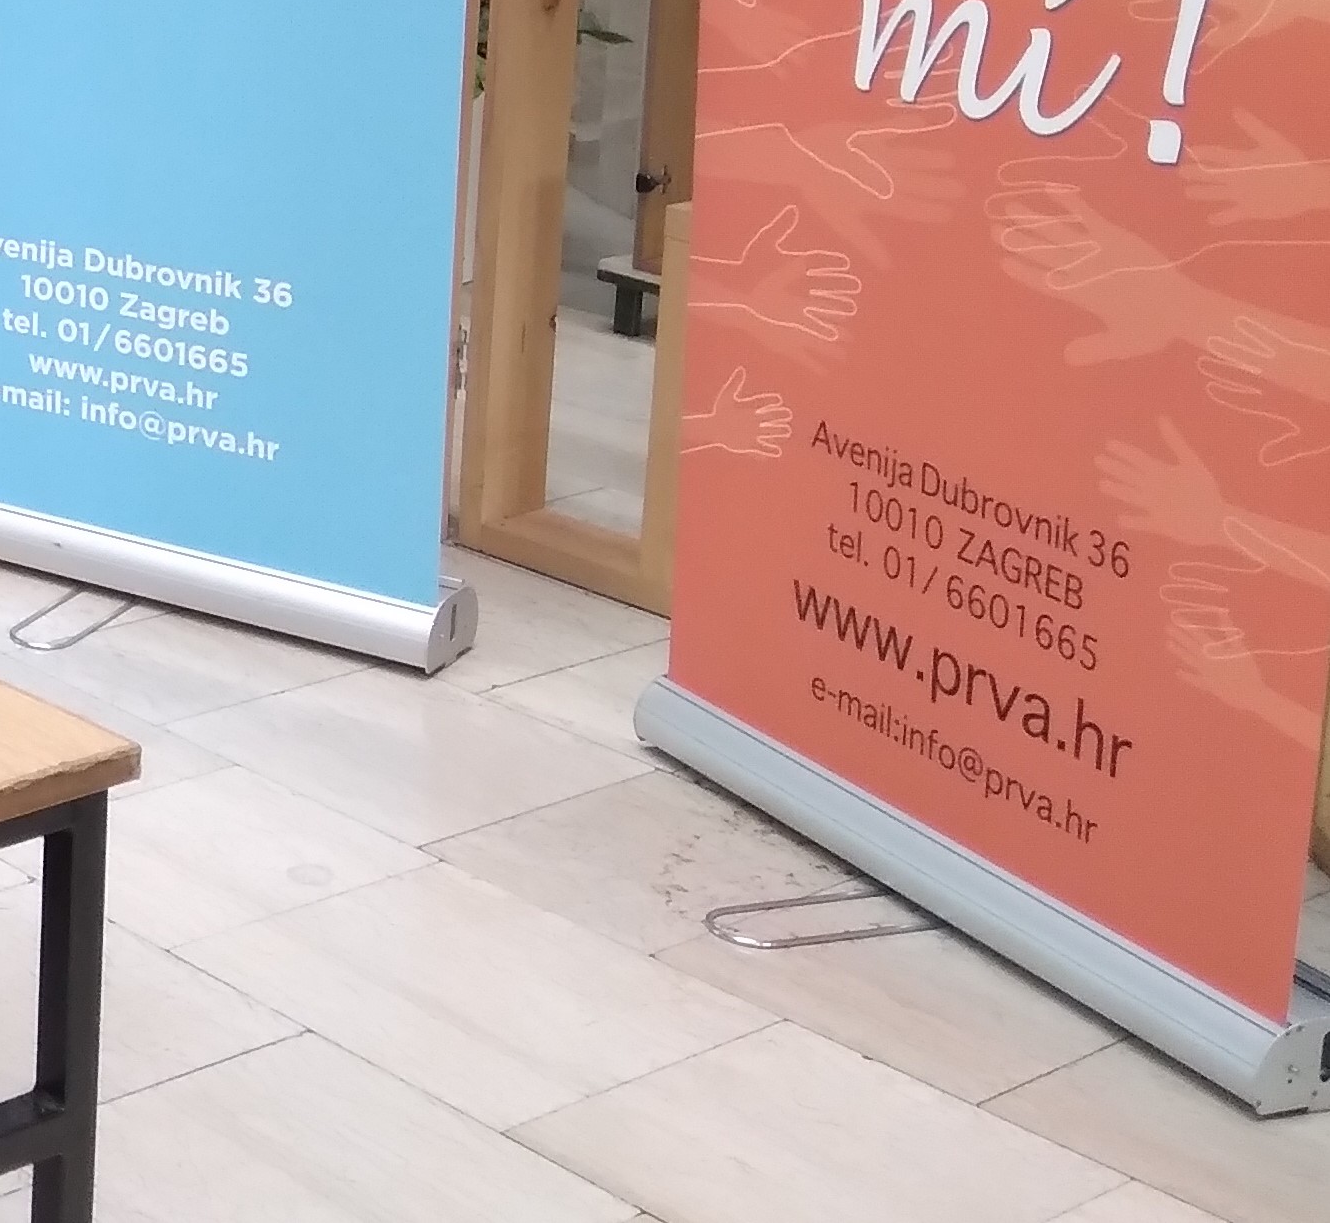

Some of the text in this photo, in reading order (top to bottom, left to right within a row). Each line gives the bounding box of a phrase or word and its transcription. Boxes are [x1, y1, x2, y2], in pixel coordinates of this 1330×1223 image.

[20, 274, 229, 336] 10010 Zagreb
[83, 247, 241, 300] Dubrovnik
[252, 277, 294, 308] 36
[2, 307, 47, 339] tel.
[28, 353, 219, 410] www.prva.hr
[80, 396, 280, 462] info@prva.hr
[810, 419, 1130, 579] Avenija Dubrovnik 36
[827, 522, 869, 567] tel.
[848, 480, 1084, 610] 10010 ZAGREB
[793, 578, 1133, 779] www.prva.hr
